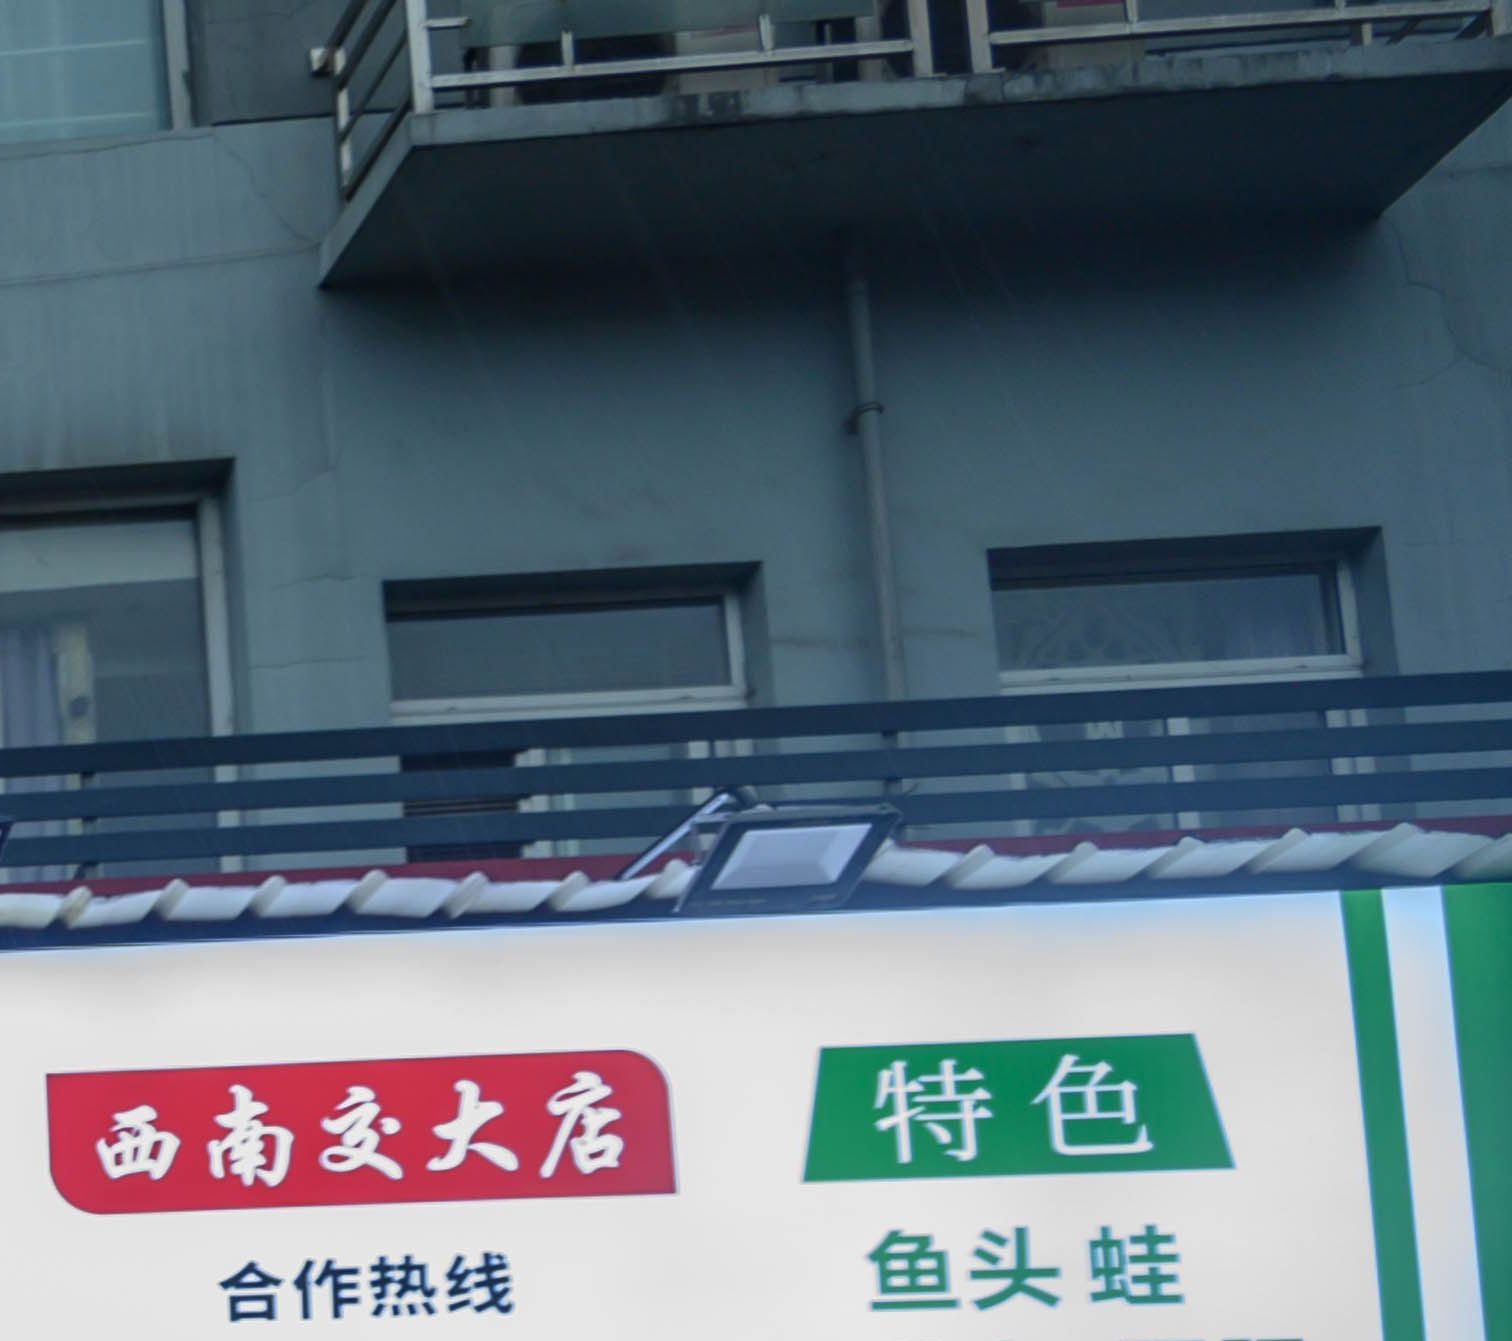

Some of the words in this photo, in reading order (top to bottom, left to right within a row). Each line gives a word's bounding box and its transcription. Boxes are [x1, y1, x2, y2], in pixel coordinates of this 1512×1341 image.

[96, 1071, 628, 1187] 西南交大店
[872, 1054, 1154, 1164] 特色
[220, 1253, 514, 1322] 合作热线
[867, 1227, 1062, 1311] 鱼头
[1089, 1224, 1185, 1306] 蛙
